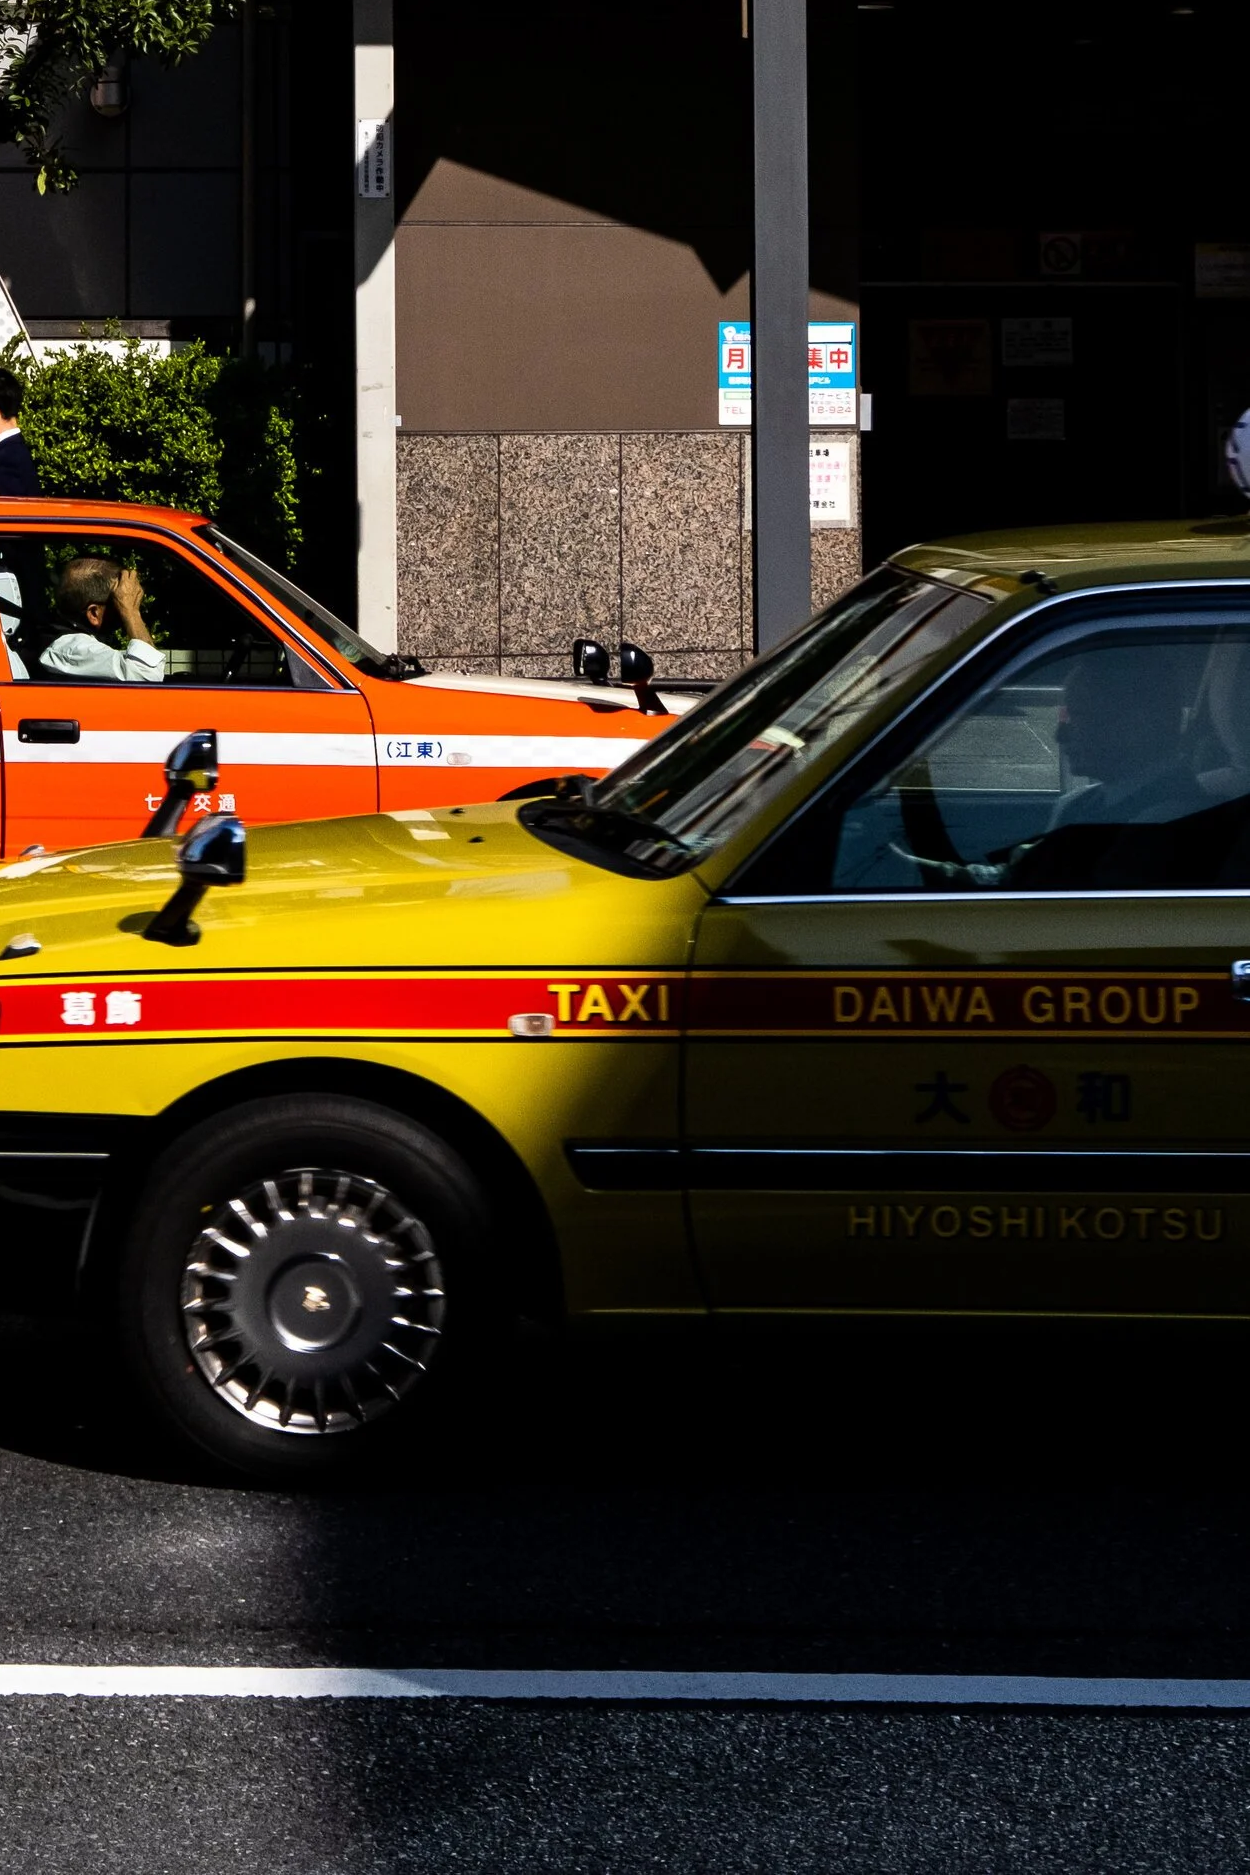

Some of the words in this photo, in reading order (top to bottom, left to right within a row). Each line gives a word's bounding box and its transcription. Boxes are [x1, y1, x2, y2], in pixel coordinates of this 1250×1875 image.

[386, 740, 445, 759] (江東)
[144, 792, 237, 813] 七交通
[547, 984, 669, 1022] TAXI
[833, 985, 995, 1023] DAIWA
[1022, 985, 1200, 1023] GROUP
